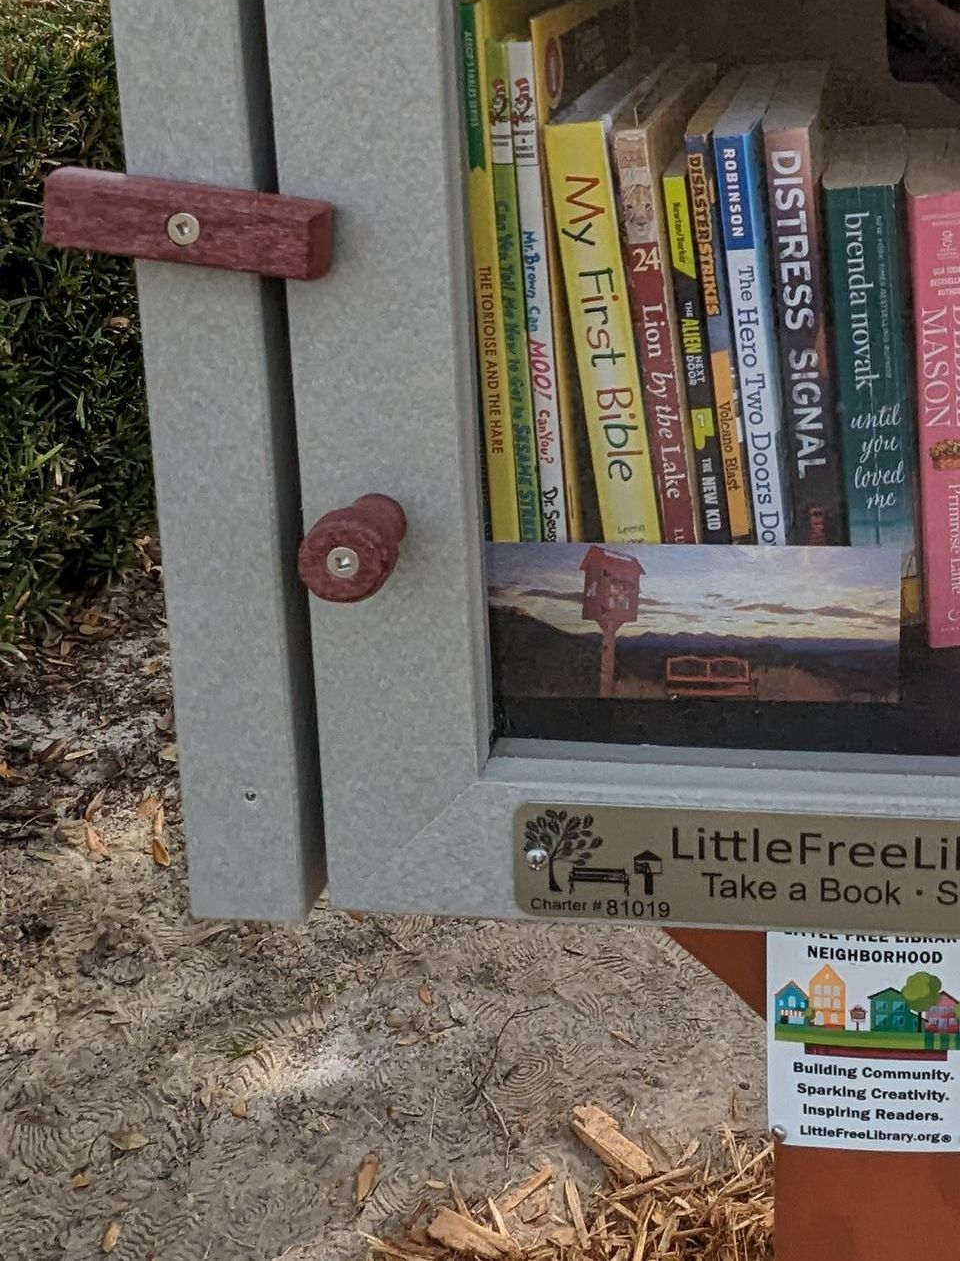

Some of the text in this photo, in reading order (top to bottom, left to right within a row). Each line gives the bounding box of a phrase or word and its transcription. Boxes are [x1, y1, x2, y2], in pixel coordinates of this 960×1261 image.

[561, 176, 605, 246] My
[724, 148, 744, 237] ROBINSON
[632, 247, 661, 273] 24
[771, 150, 814, 330] DISTRESS
[738, 266, 754, 301] The
[844, 211, 880, 391] brenda novak
[528, 306, 541, 331] Can
[578, 267, 625, 367] First
[681, 301, 705, 383] THE ALIEN NEXT
[738, 308, 760, 367] Hero
[479, 267, 503, 453] THE TORTOISE AND THE HARE
[529, 340, 552, 401] MOO!
[686, 356, 697, 386] DOOR
[921, 306, 951, 427] MASON
[642, 303, 686, 499] Lion by the Lake
[745, 373, 766, 426] Two
[789, 349, 826, 479] SIGNAL
[851, 403, 901, 429] until
[596, 387, 643, 482] Bible
[718, 401, 739, 491] Volcano Blast
[860, 433, 898, 463] you
[702, 457, 721, 531] THE NEW KID
[750, 432, 772, 504] Doors
[855, 461, 905, 489] loved
[543, 487, 558, 507] Dr.
[866, 493, 897, 509] me
[530, 897, 586, 912] Charter
[606, 899, 671, 918] 81019
[701, 872, 777, 899] Take
[788, 881, 807, 902] a
[820, 878, 900, 904] Book
[808, 945, 943, 963] NEIGHBORHOOD
[793, 1061, 954, 1083] Building Community.
[797, 1083, 950, 1103] Sparking Creativity.
[803, 1103, 944, 1121] Inspiring Readers.
